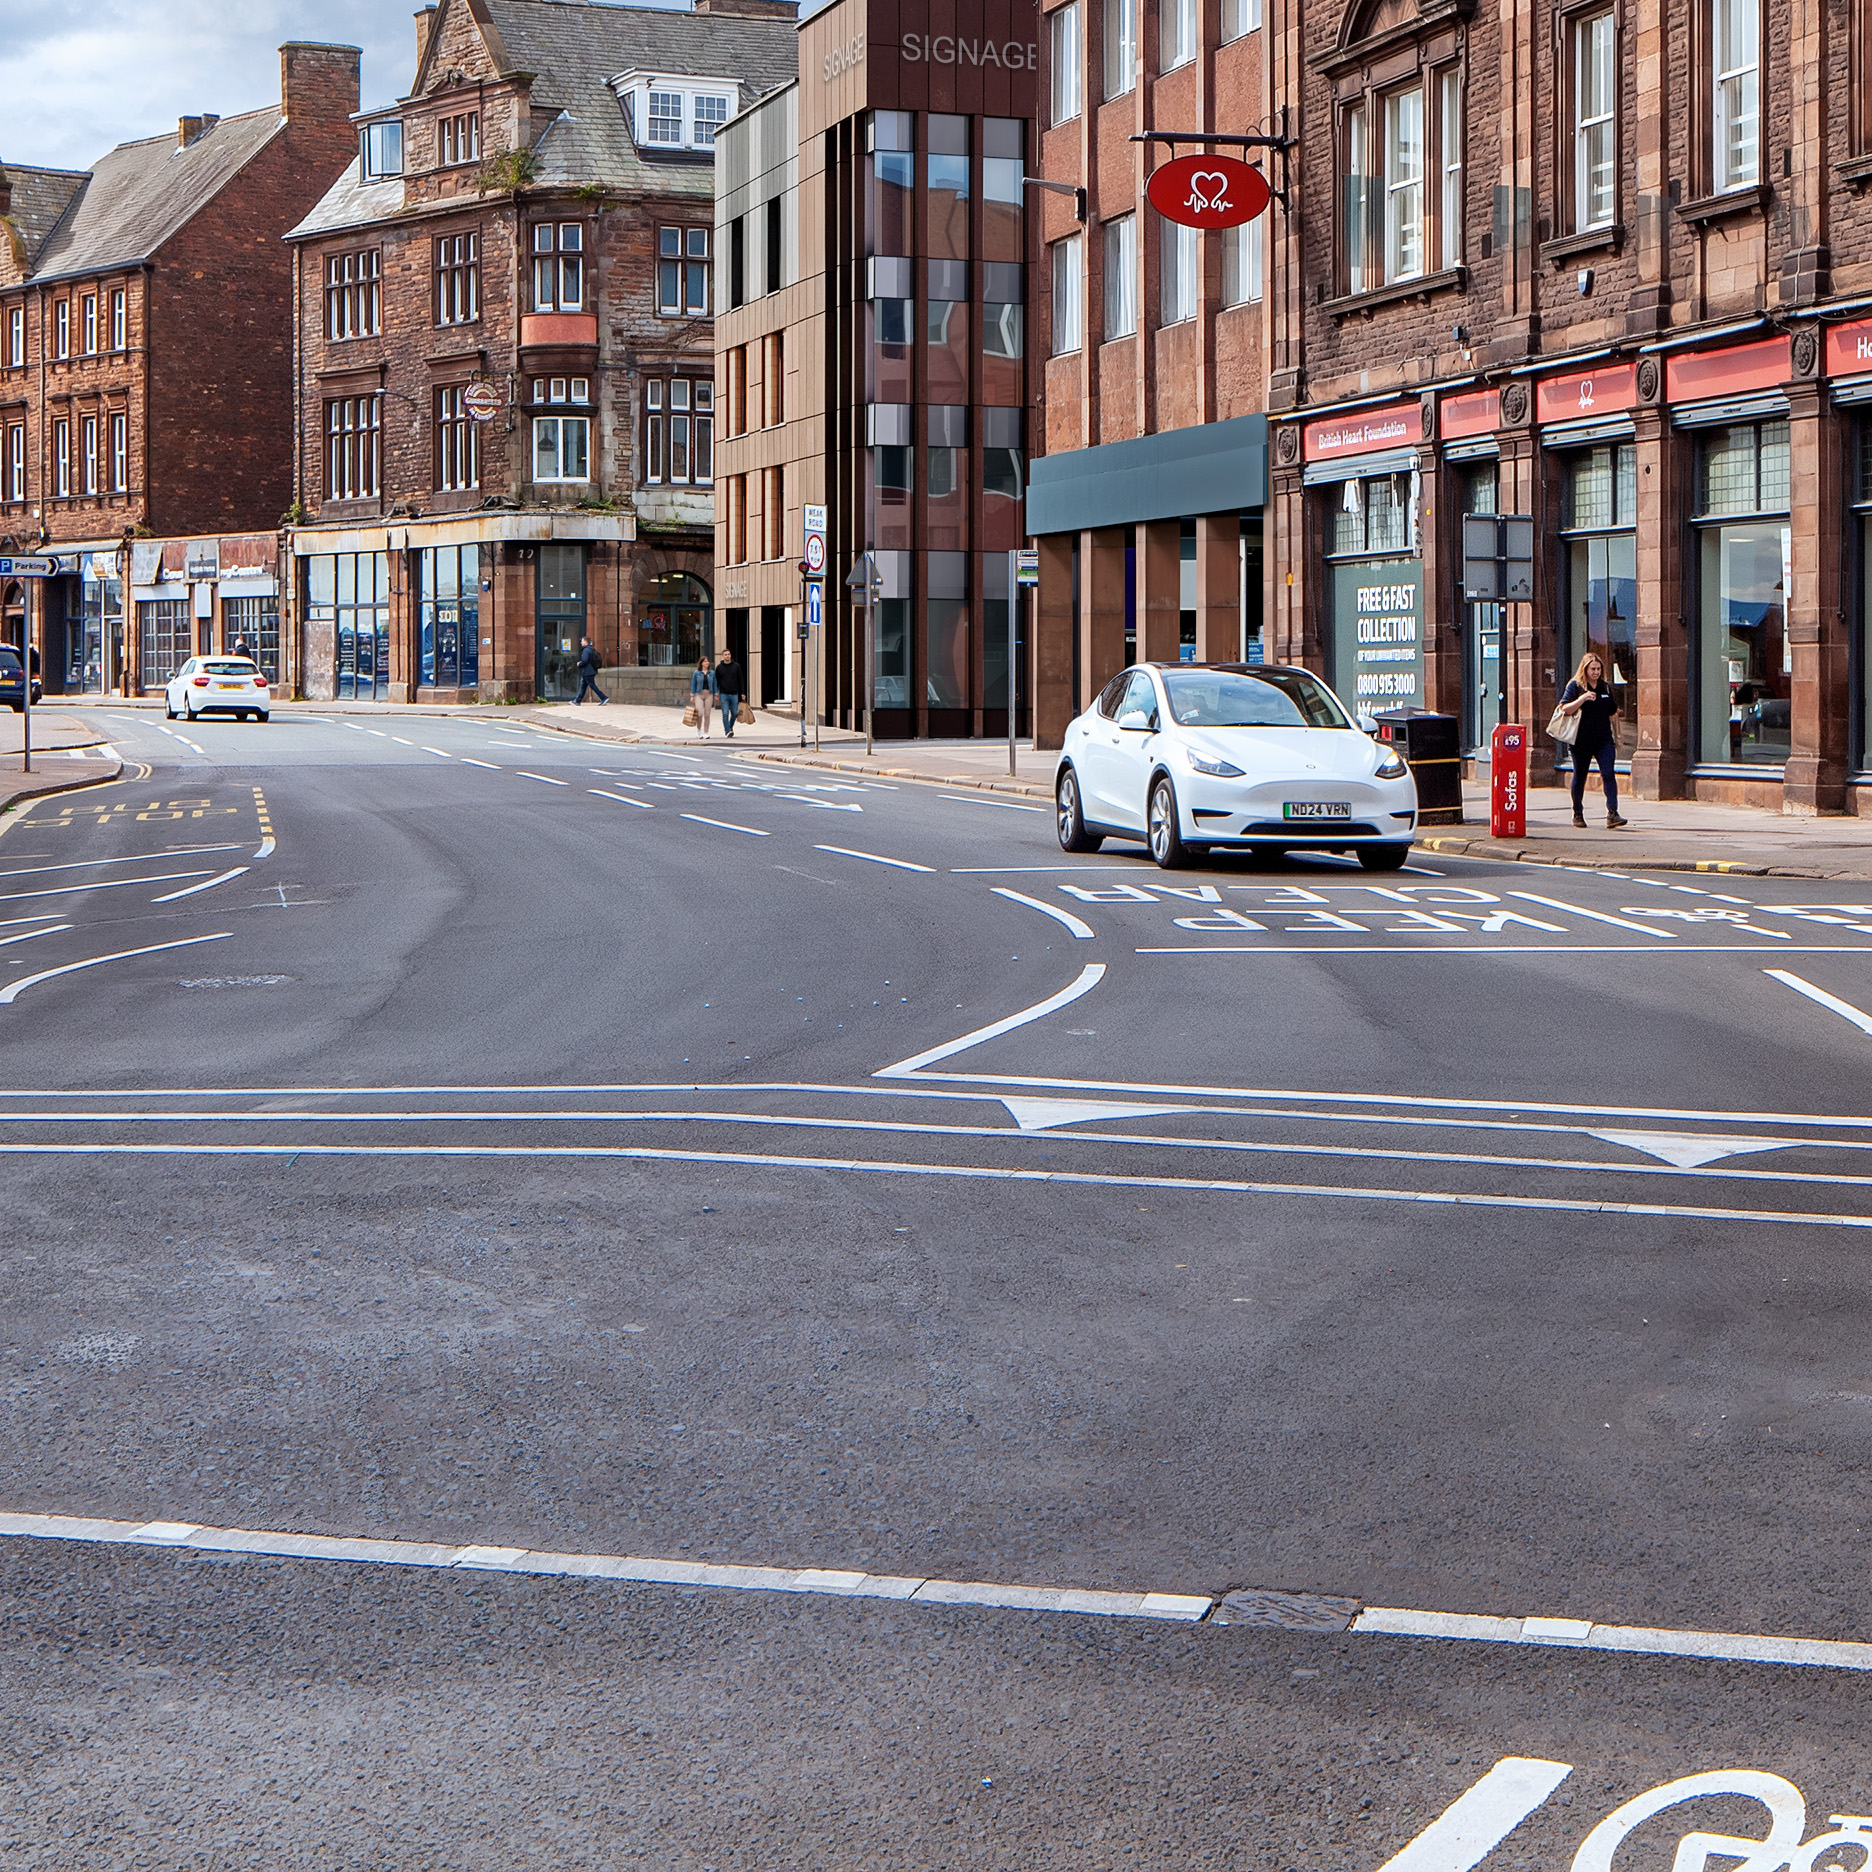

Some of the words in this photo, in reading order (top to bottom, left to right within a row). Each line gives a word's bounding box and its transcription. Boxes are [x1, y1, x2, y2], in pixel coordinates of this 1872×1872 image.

[824, 32, 864, 82] SIGNAGE
[901, 33, 1037, 70] SIGNAGE
[1318, 431, 1341, 449] British
[1342, 428, 1363, 445] Heart
[1364, 421, 1407, 442] Foundation
[808, 518, 823, 528] ROAD
[15, 562, 47, 571] Parking
[725, 580, 747, 599] SIGNAGE
[1357, 586, 1382, 613] FREE
[1382, 586, 1390, 612] &
[1390, 584, 1415, 610] FAST
[1357, 616, 1416, 643] COLLECTION
[1357, 673, 1379, 696] 0800
[1379, 673, 1393, 695] 915
[1393, 673, 1416, 695] 3000
[1504, 770, 1517, 812] Sofas
[22, 808, 237, 828] STOP
[59, 799, 211, 816] BUS
[1291, 804, 1322, 815] ND24
[1325, 804, 1348, 815] VRN
[1056, 883, 1502, 905] CLEAR
[1173, 908, 1571, 934] KEEP
